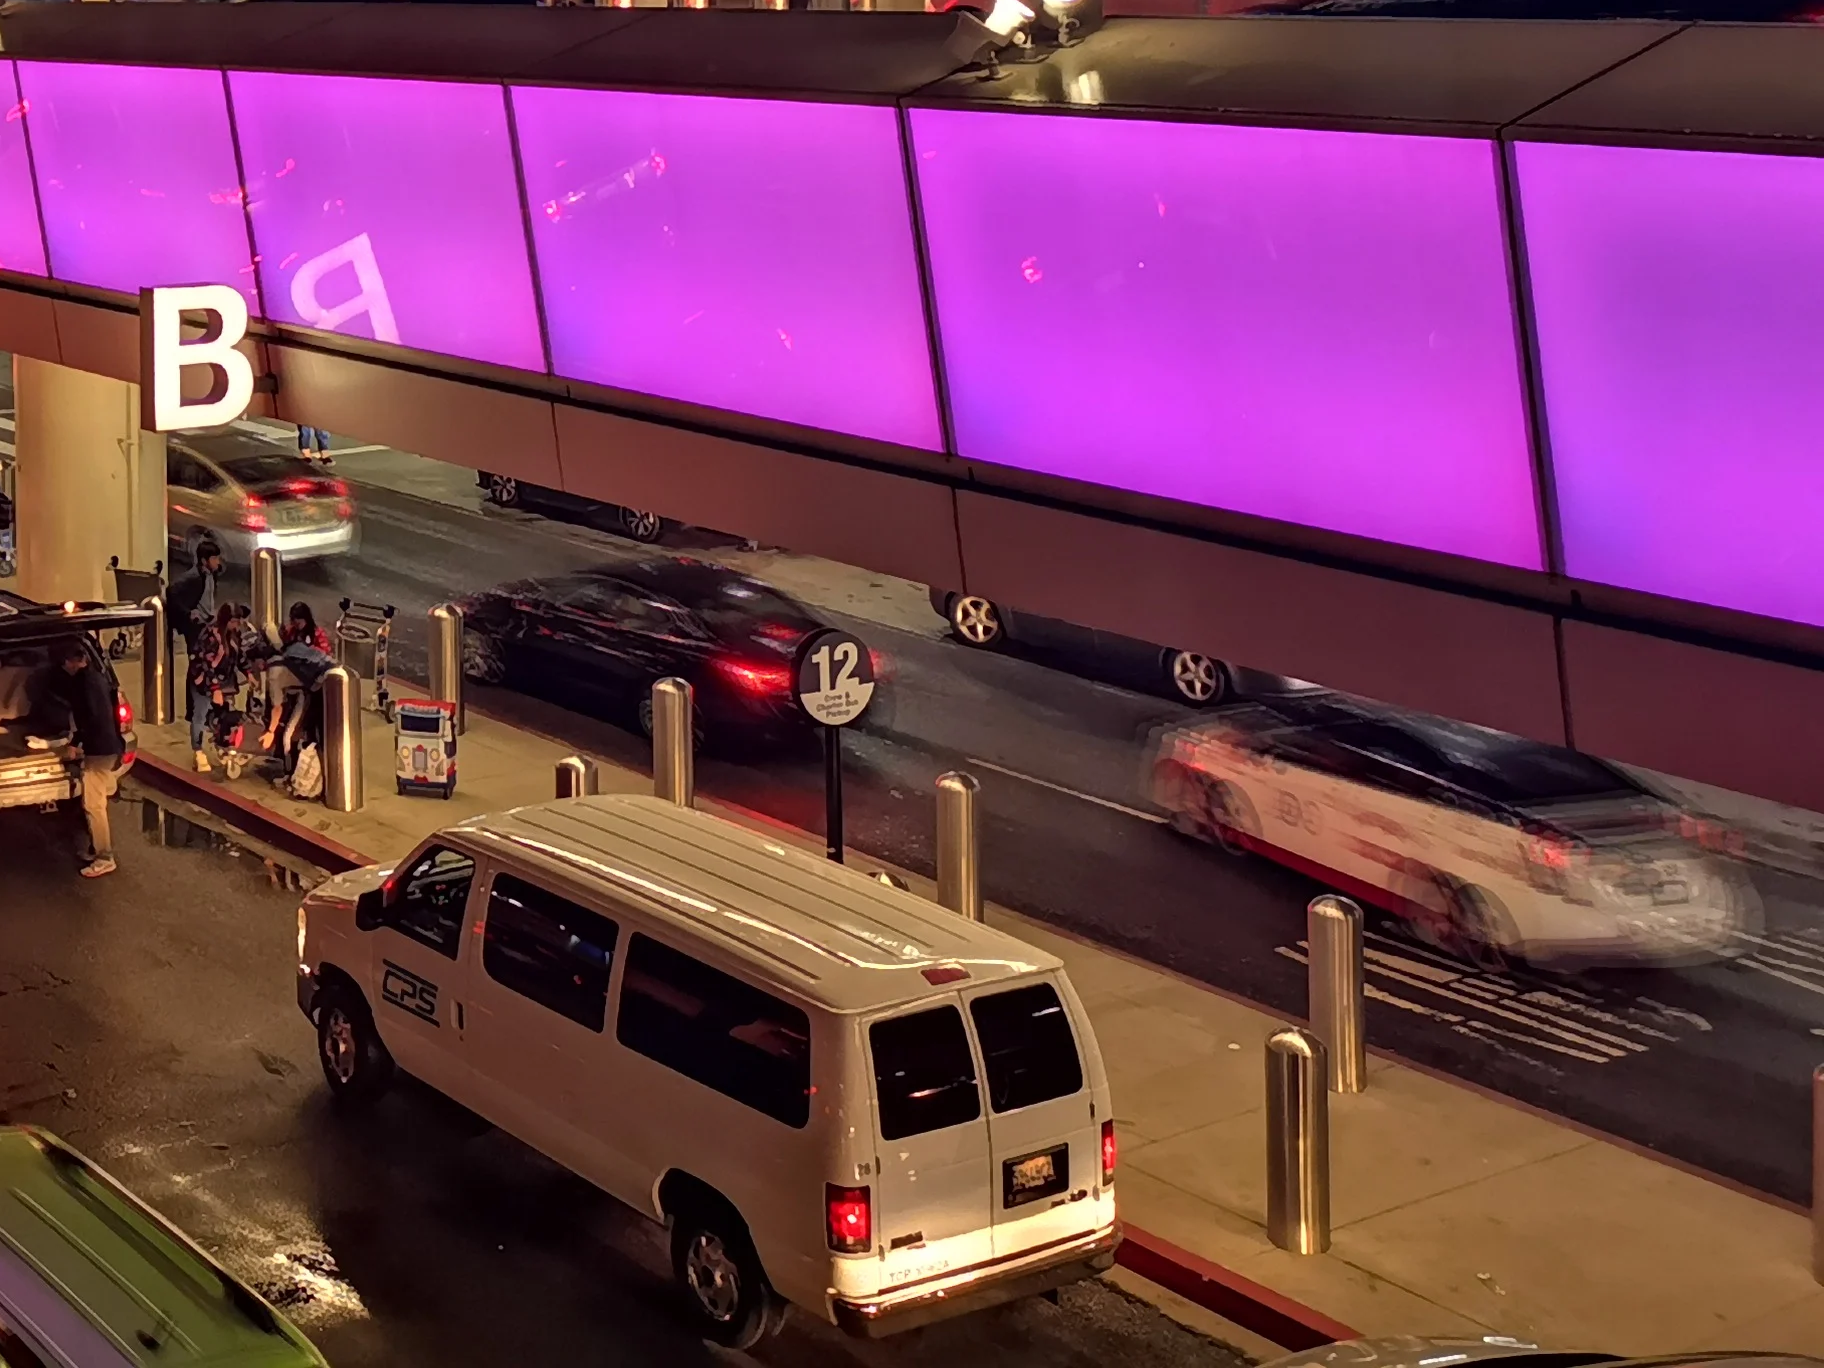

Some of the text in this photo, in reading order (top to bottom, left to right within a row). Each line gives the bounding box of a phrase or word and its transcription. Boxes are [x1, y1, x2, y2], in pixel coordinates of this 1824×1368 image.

[148, 284, 254, 432] B
[811, 642, 859, 692] 12
[382, 968, 437, 1016] CPS
